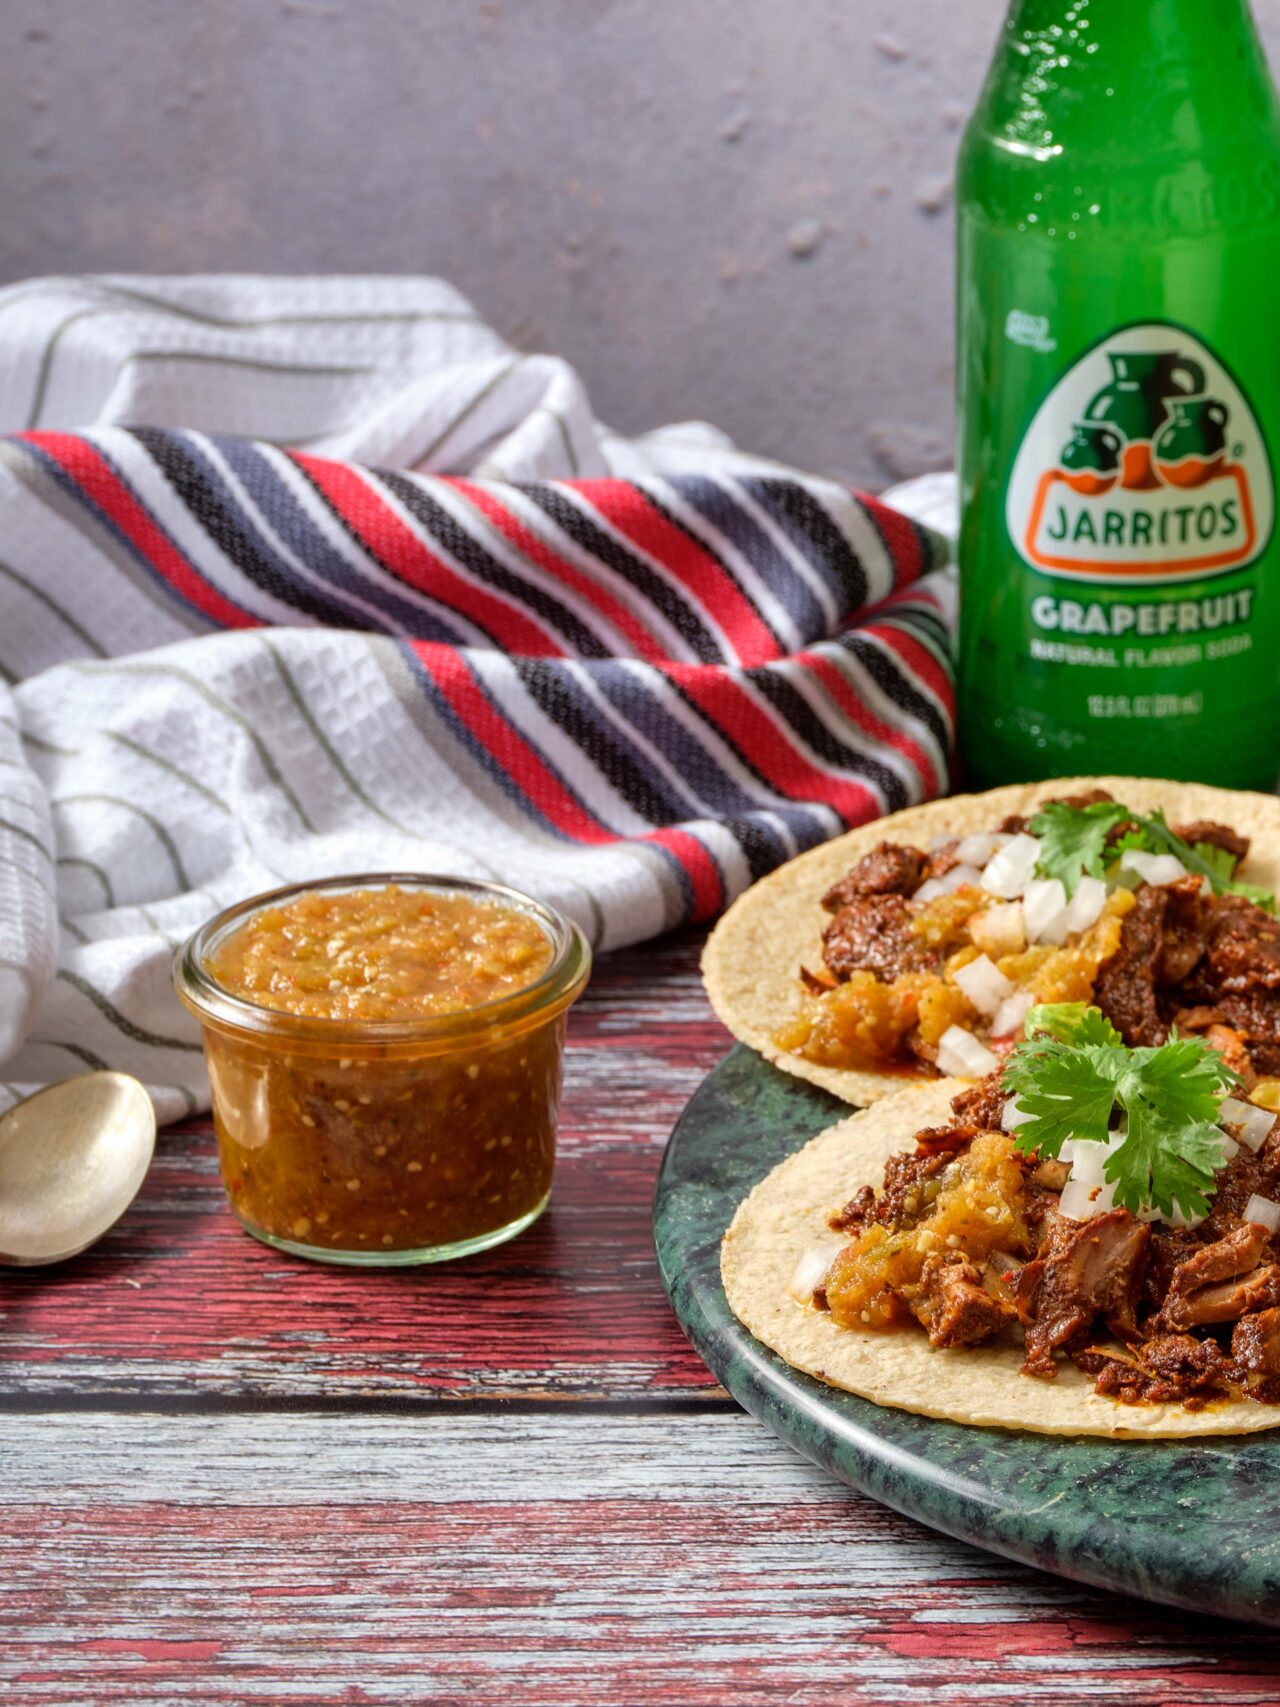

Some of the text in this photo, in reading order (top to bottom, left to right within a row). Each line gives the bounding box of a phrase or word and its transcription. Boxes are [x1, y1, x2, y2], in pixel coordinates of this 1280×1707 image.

[1047, 500, 1238, 547] JARRITOS
[1031, 588, 1253, 636] GRAPEFRUIT
[1030, 638, 1120, 668] NATURAL
[1123, 643, 1203, 668] FLAVOR
